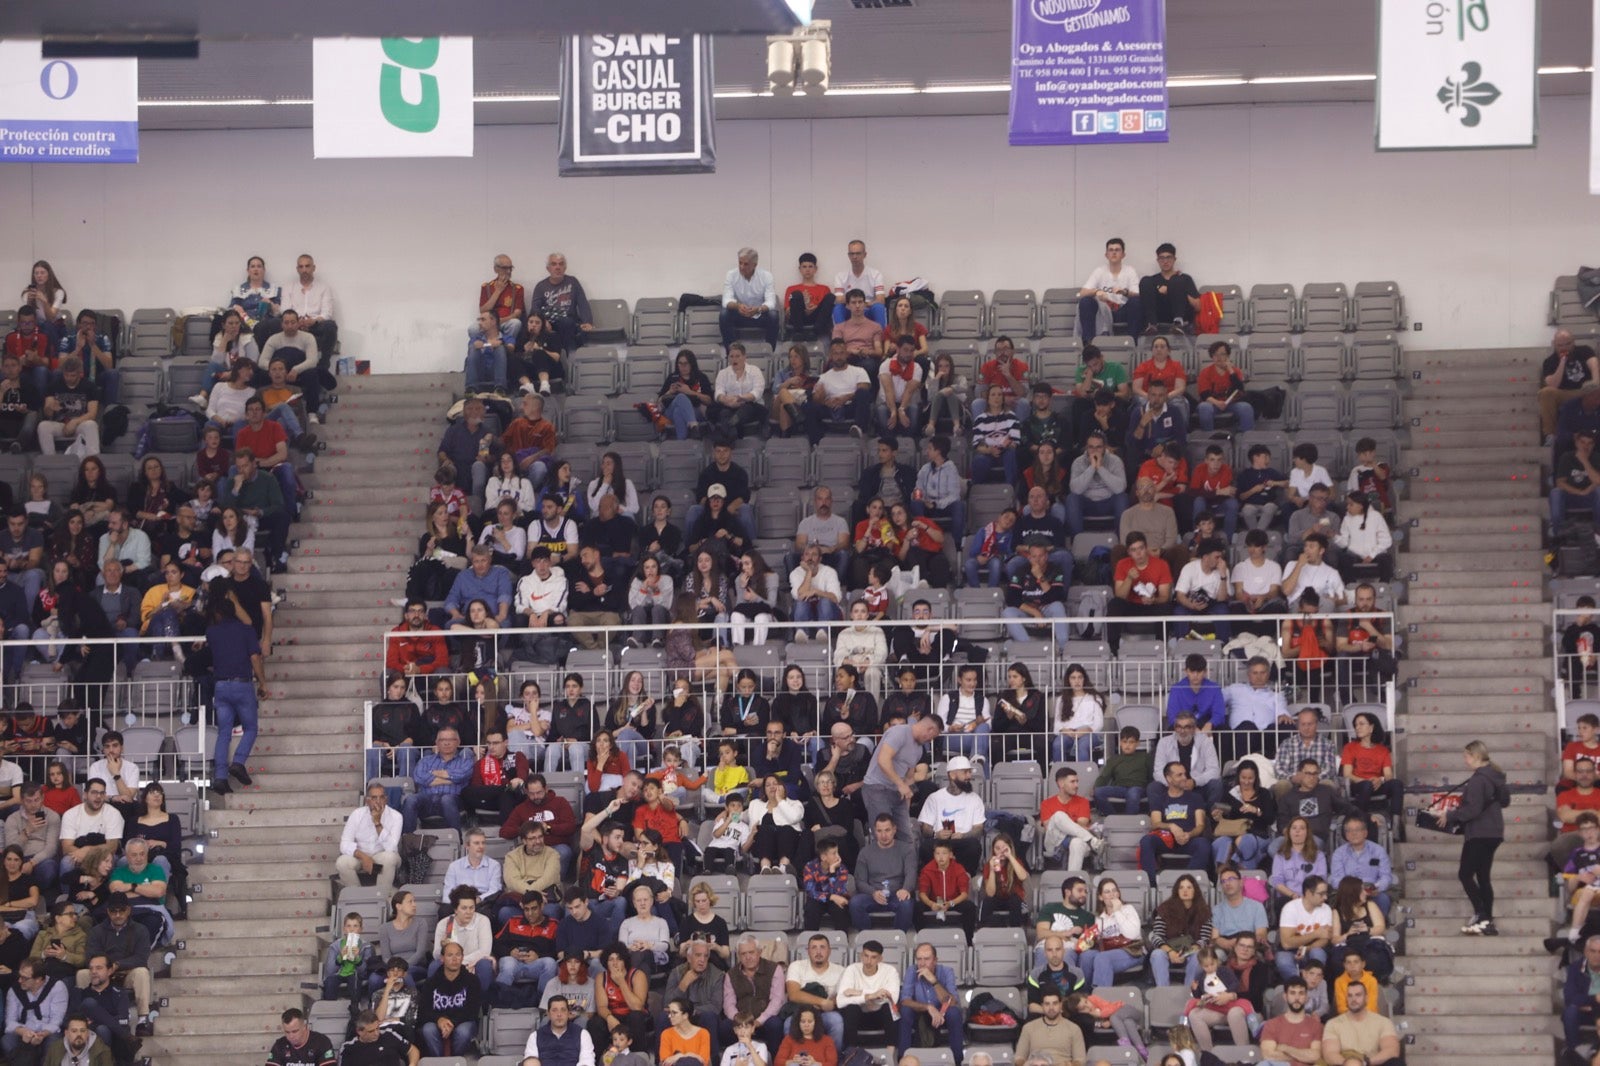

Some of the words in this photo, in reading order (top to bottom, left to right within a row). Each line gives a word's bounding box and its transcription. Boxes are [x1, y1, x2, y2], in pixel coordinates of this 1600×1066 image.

[1064, 6, 1131, 33] GESTIONAMOS
[591, 34, 681, 58] SAN-
[1020, 43, 1043, 56] Oya
[1046, 42, 1099, 55] Abogados
[1102, 41, 1112, 52] &
[1116, 41, 1163, 51] Asesores
[1012, 57, 1044, 66] Camino
[1045, 56, 1056, 65] de
[1129, 54, 1164, 63] Granada
[592, 58, 681, 90] CASUAL
[1035, 68, 1051, 77] 958
[1052, 68, 1068, 76] 094
[1070, 68, 1086, 76] 400
[1094, 66, 1112, 76] Fax.
[1113, 66, 1130, 75] 958
[1130, 66, 1146, 74] 094
[1148, 65, 1164, 74] 399
[1035, 79, 1164, 93] info@oyaabogados.com
[592, 91, 681, 112] BURGER
[1038, 93, 1164, 106] www.oyaabogados.com
[0, 128, 69, 142] Protección
[73, 130, 116, 142] contra
[594, 112, 681, 144] -CHO
[4, 144, 34, 156] robo
[38, 146, 46, 156] e
[49, 144, 111, 156] incendios
